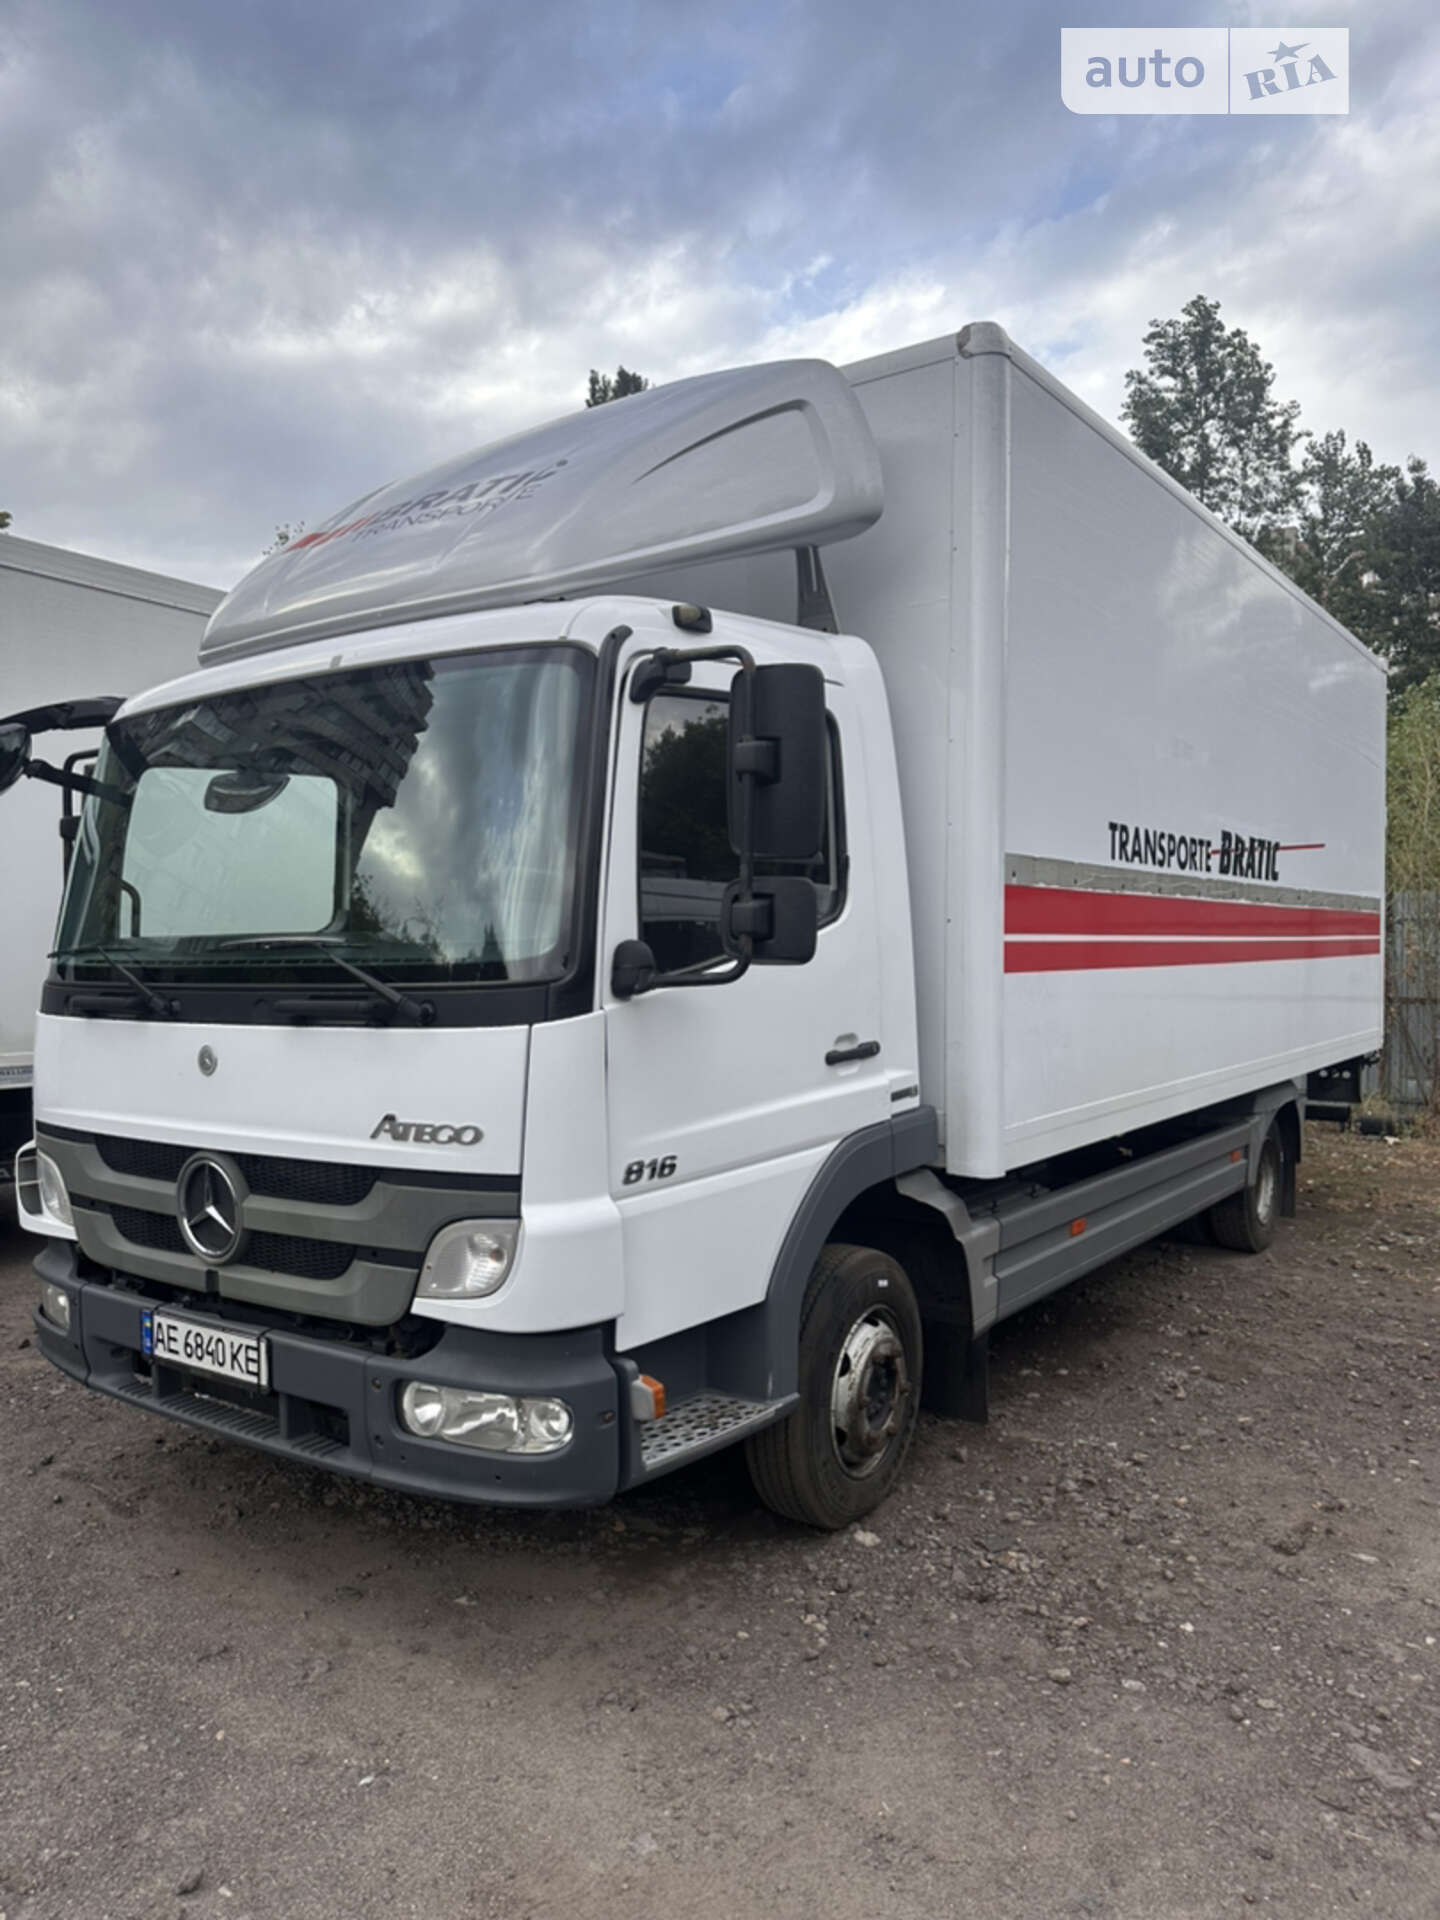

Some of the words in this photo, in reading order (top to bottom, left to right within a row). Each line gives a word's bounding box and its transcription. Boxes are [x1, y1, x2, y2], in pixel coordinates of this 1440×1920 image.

[1108, 821, 1212, 873] TRANSPORTE
[1218, 829, 1281, 882] BRATIC
[621, 1154, 678, 1186] 816
[154, 1321, 180, 1356] AE
[184, 1329, 226, 1368] 6840
[230, 1341, 260, 1377] KE
